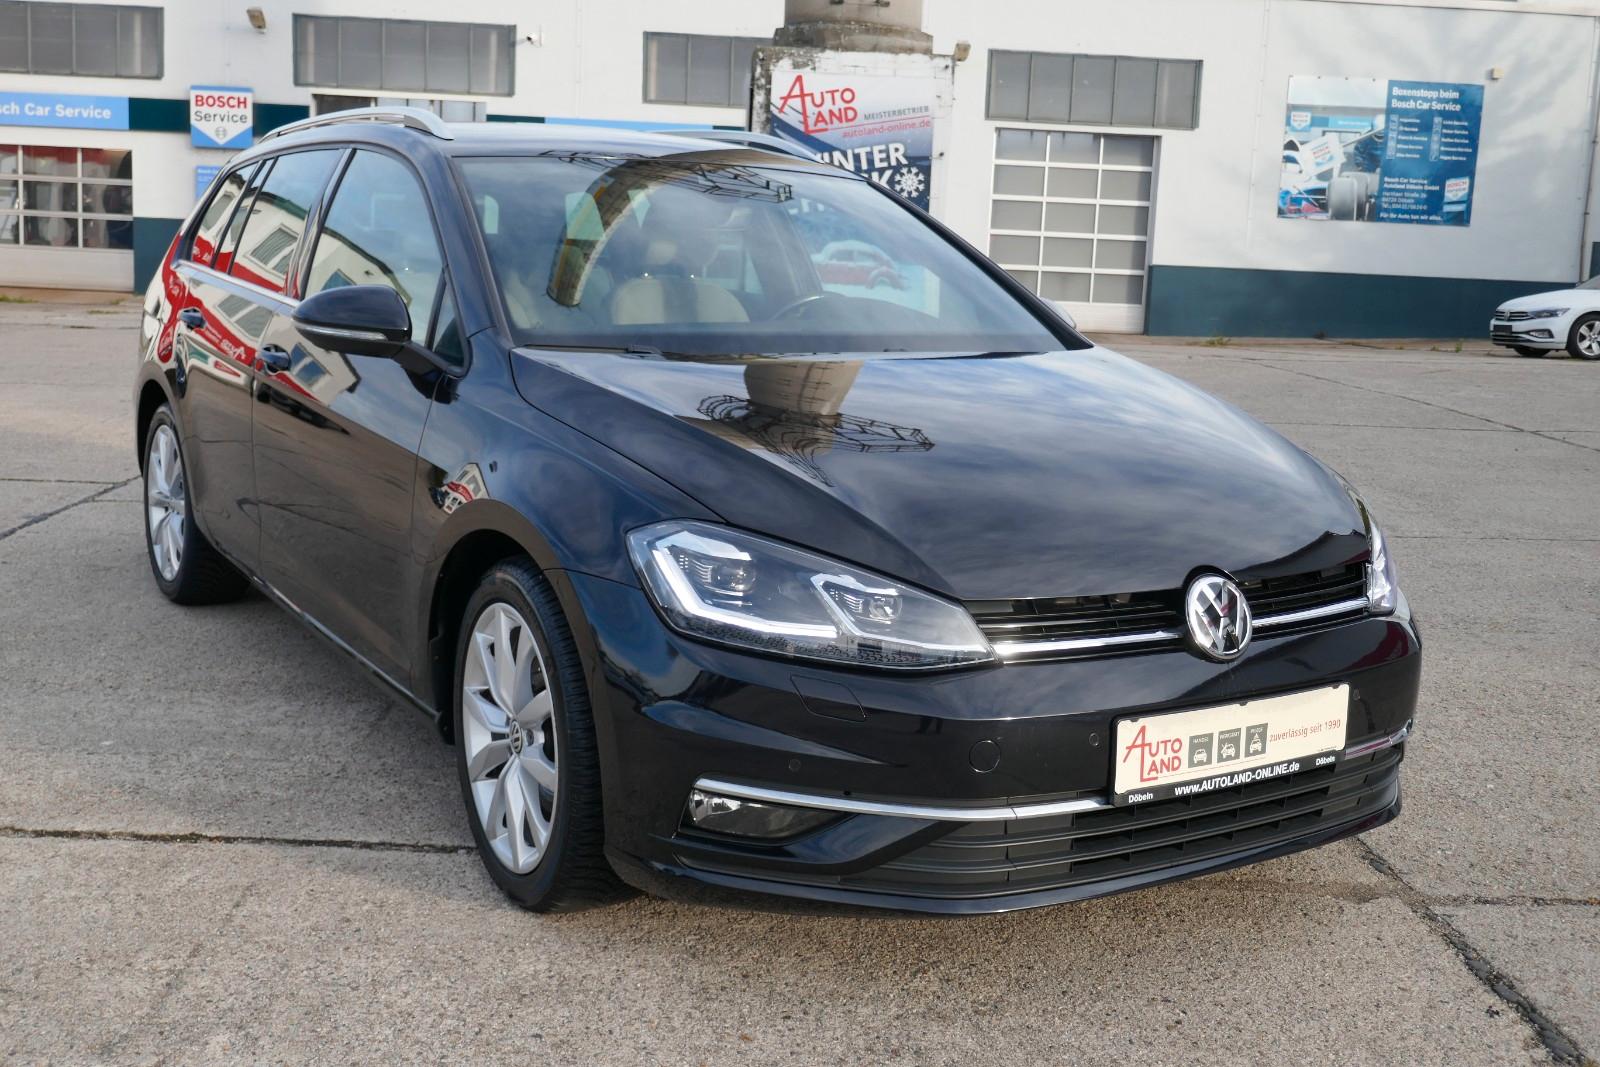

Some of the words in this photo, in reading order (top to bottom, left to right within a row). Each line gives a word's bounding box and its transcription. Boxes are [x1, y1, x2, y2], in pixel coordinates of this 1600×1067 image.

[1392, 87, 1438, 99] Boxenstopp
[1440, 89, 1459, 98] beim
[194, 94, 248, 109] BOSCH
[1392, 98, 1415, 109] Bosch
[1416, 100, 1430, 110] Car
[1431, 101, 1461, 111] Service
[24, 102, 51, 116] Car
[55, 103, 112, 120] Service
[193, 110, 248, 124] Service
[864, 105, 929, 121] MEISTERBETRIEB
[842, 119, 931, 138] autoland-online.de
[816, 142, 908, 172] NTER
[1270, 728, 1308, 742] zuverlässig
[1310, 723, 1322, 733] seit
[1325, 719, 1341, 729] 1990
[1175, 762, 1299, 796] www.AUTOLAND-ONLINE.de
[1128, 792, 1153, 803] Döbeln
